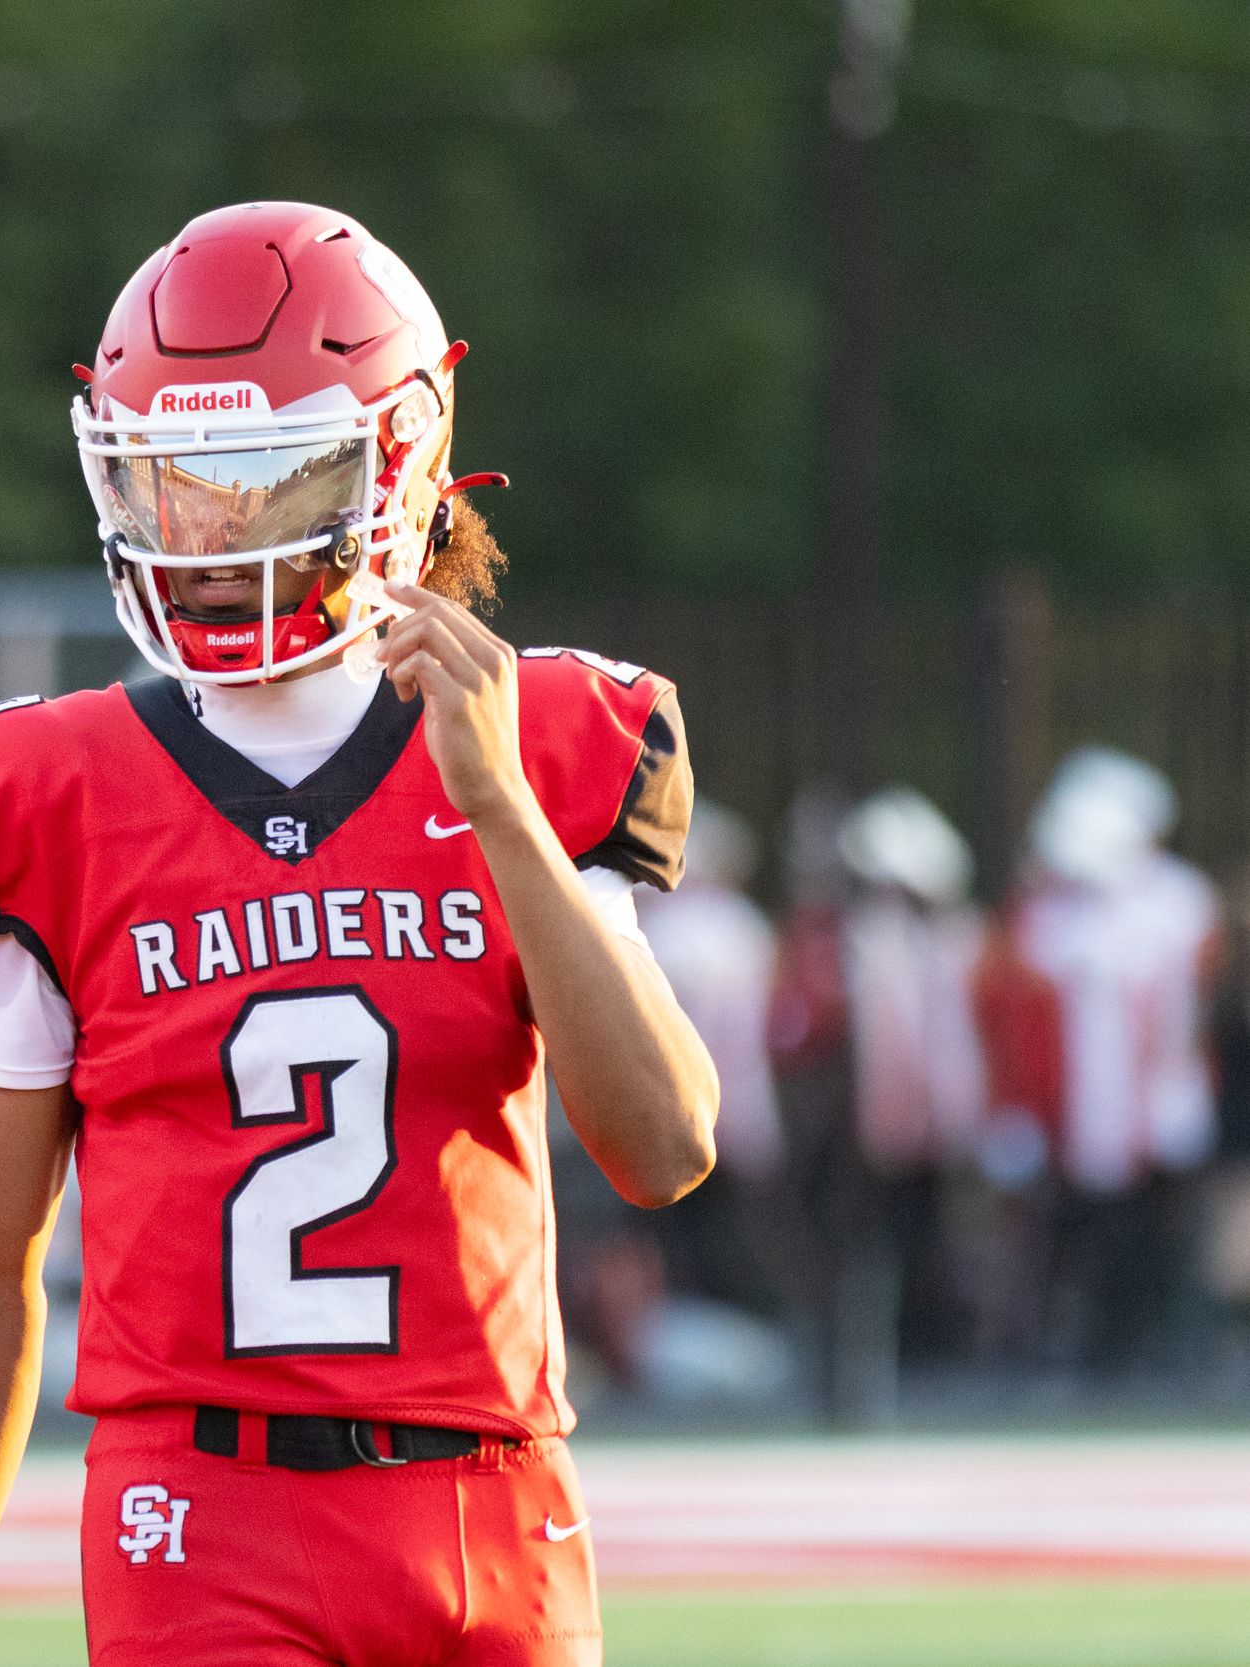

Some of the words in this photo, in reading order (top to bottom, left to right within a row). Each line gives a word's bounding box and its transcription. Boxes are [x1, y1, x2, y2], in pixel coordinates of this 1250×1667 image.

[160, 388, 252, 413] Riddell
[206, 631, 255, 647] Riddell
[265, 815, 309, 855] SH
[129, 888, 487, 997] RAIDERS
[220, 984, 401, 1359] 2
[118, 1484, 191, 1565] SH
